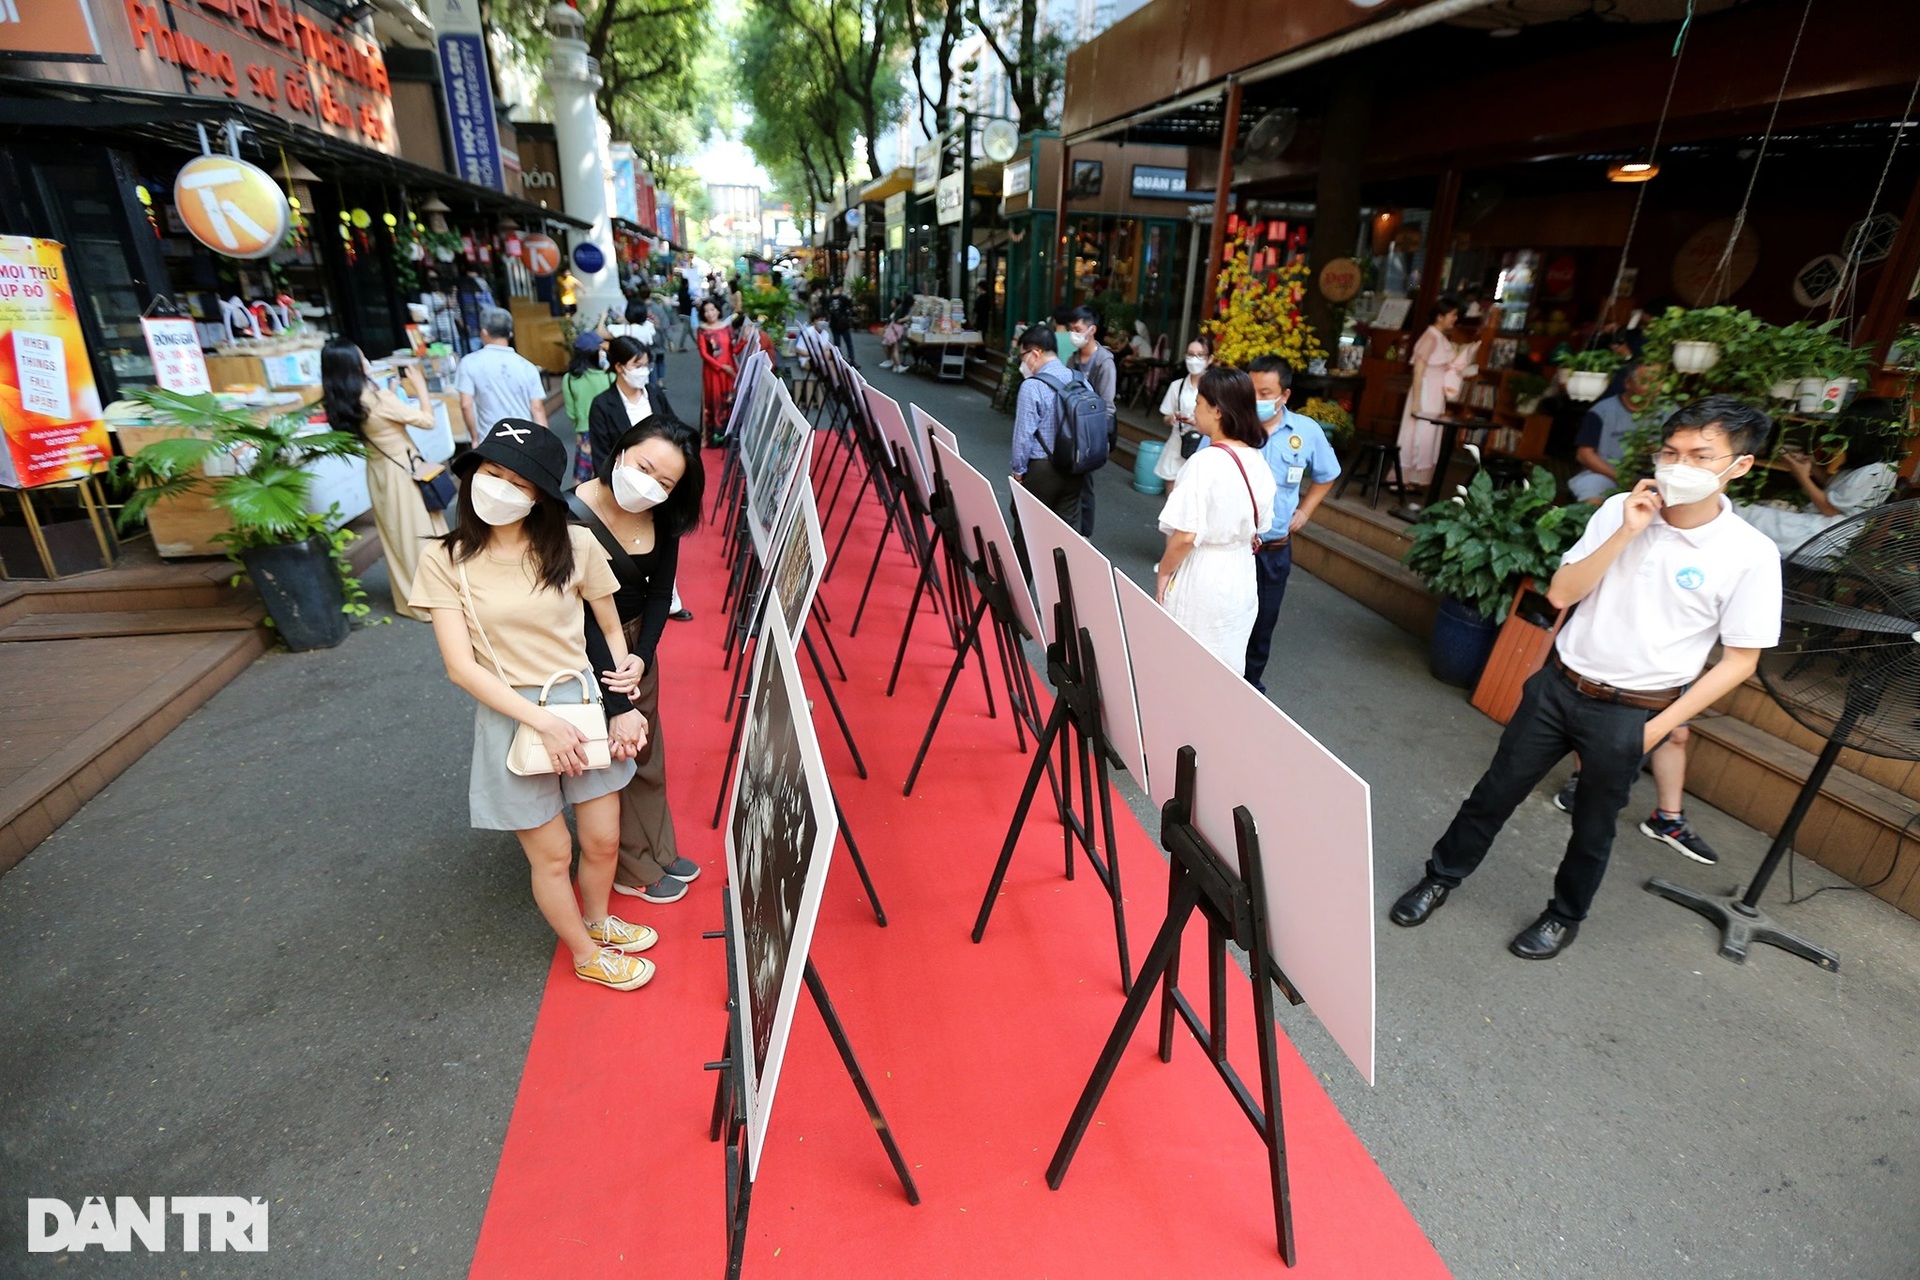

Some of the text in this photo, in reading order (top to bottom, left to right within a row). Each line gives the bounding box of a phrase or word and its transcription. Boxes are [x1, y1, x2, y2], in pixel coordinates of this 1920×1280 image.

[124, 0, 239, 98] Phụng
[246, 63, 280, 113] sự
[446, 40, 463, 76] SEN
[452, 77, 471, 116] HOA
[461, 41, 484, 125] UNIVERSITY
[459, 118, 479, 155] HỌC
[475, 126, 491, 155] SEN
[1133, 175, 1170, 191] QUÁN
[28, 264, 58, 280] THỨ
[21, 355, 57, 371] THINGS
